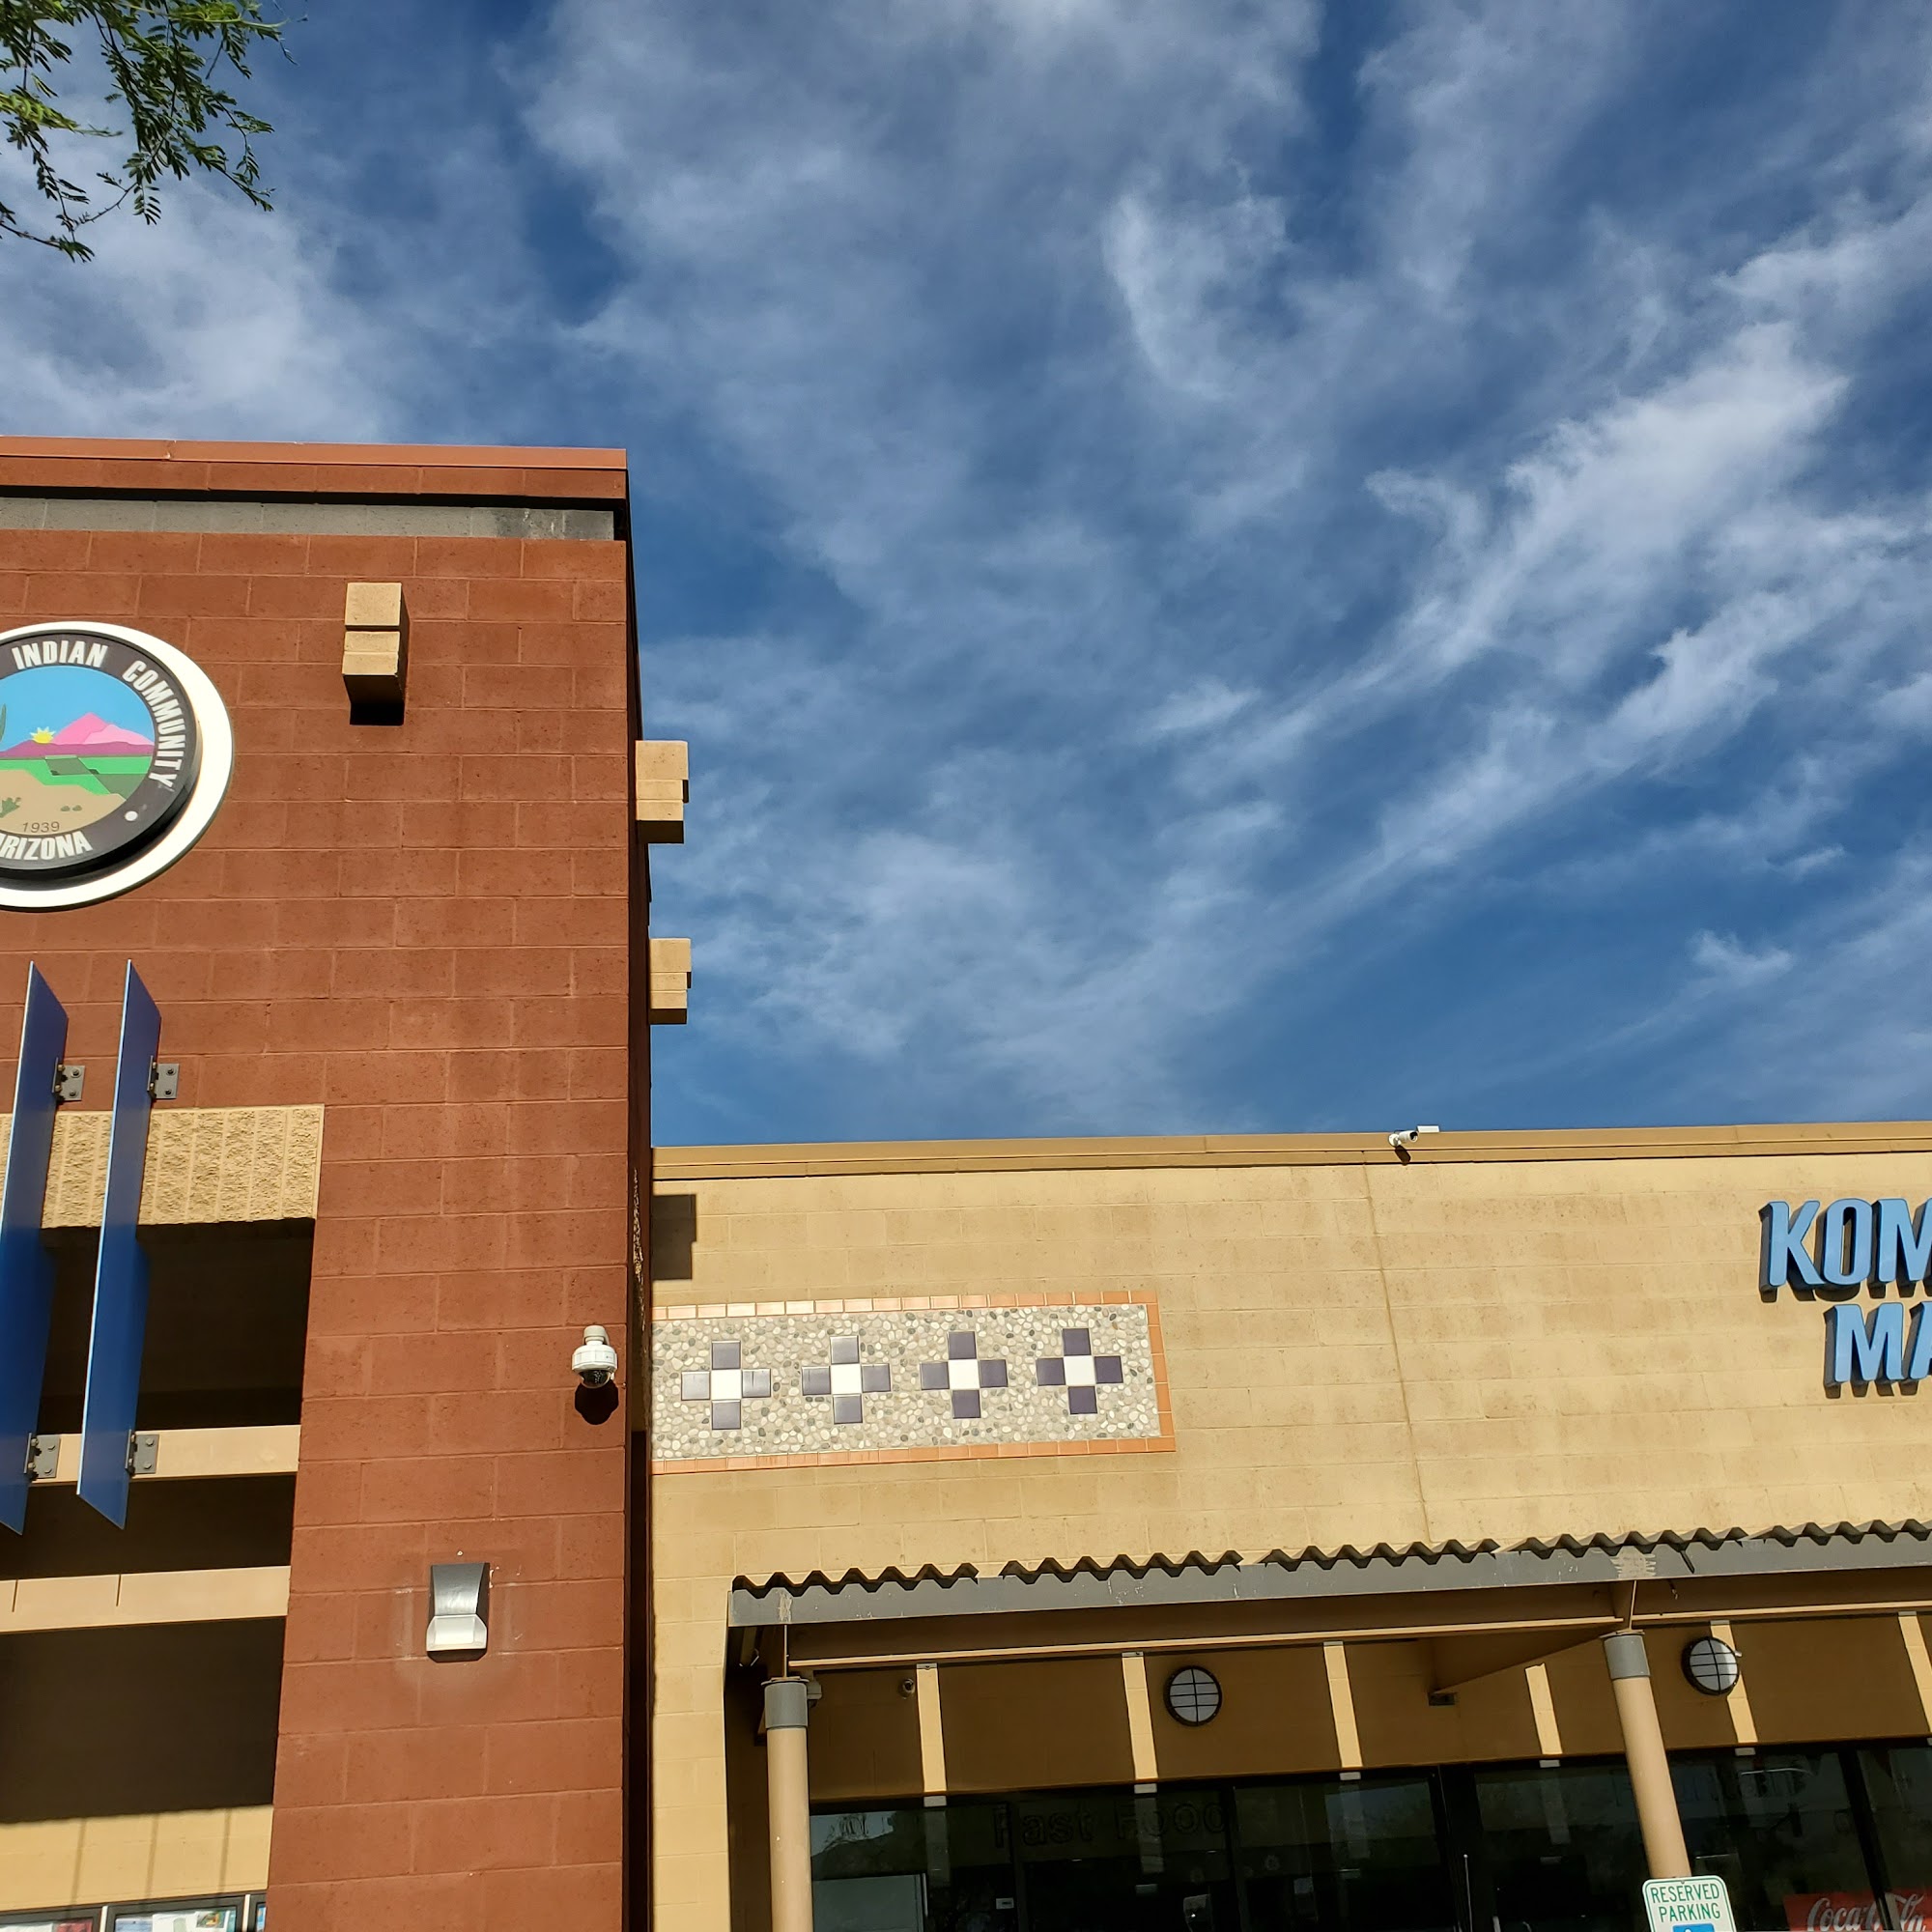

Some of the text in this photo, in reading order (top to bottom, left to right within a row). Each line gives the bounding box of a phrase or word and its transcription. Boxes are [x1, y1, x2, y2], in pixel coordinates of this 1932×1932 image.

[12, 639, 186, 788] INDIAN COMMUNITY
[22, 821, 60, 834] 1939
[1650, 1883, 1719, 1904] RESERVED
[1659, 1902, 1720, 1923] PARKING
[1806, 1893, 1927, 1932] Coca-Cla
